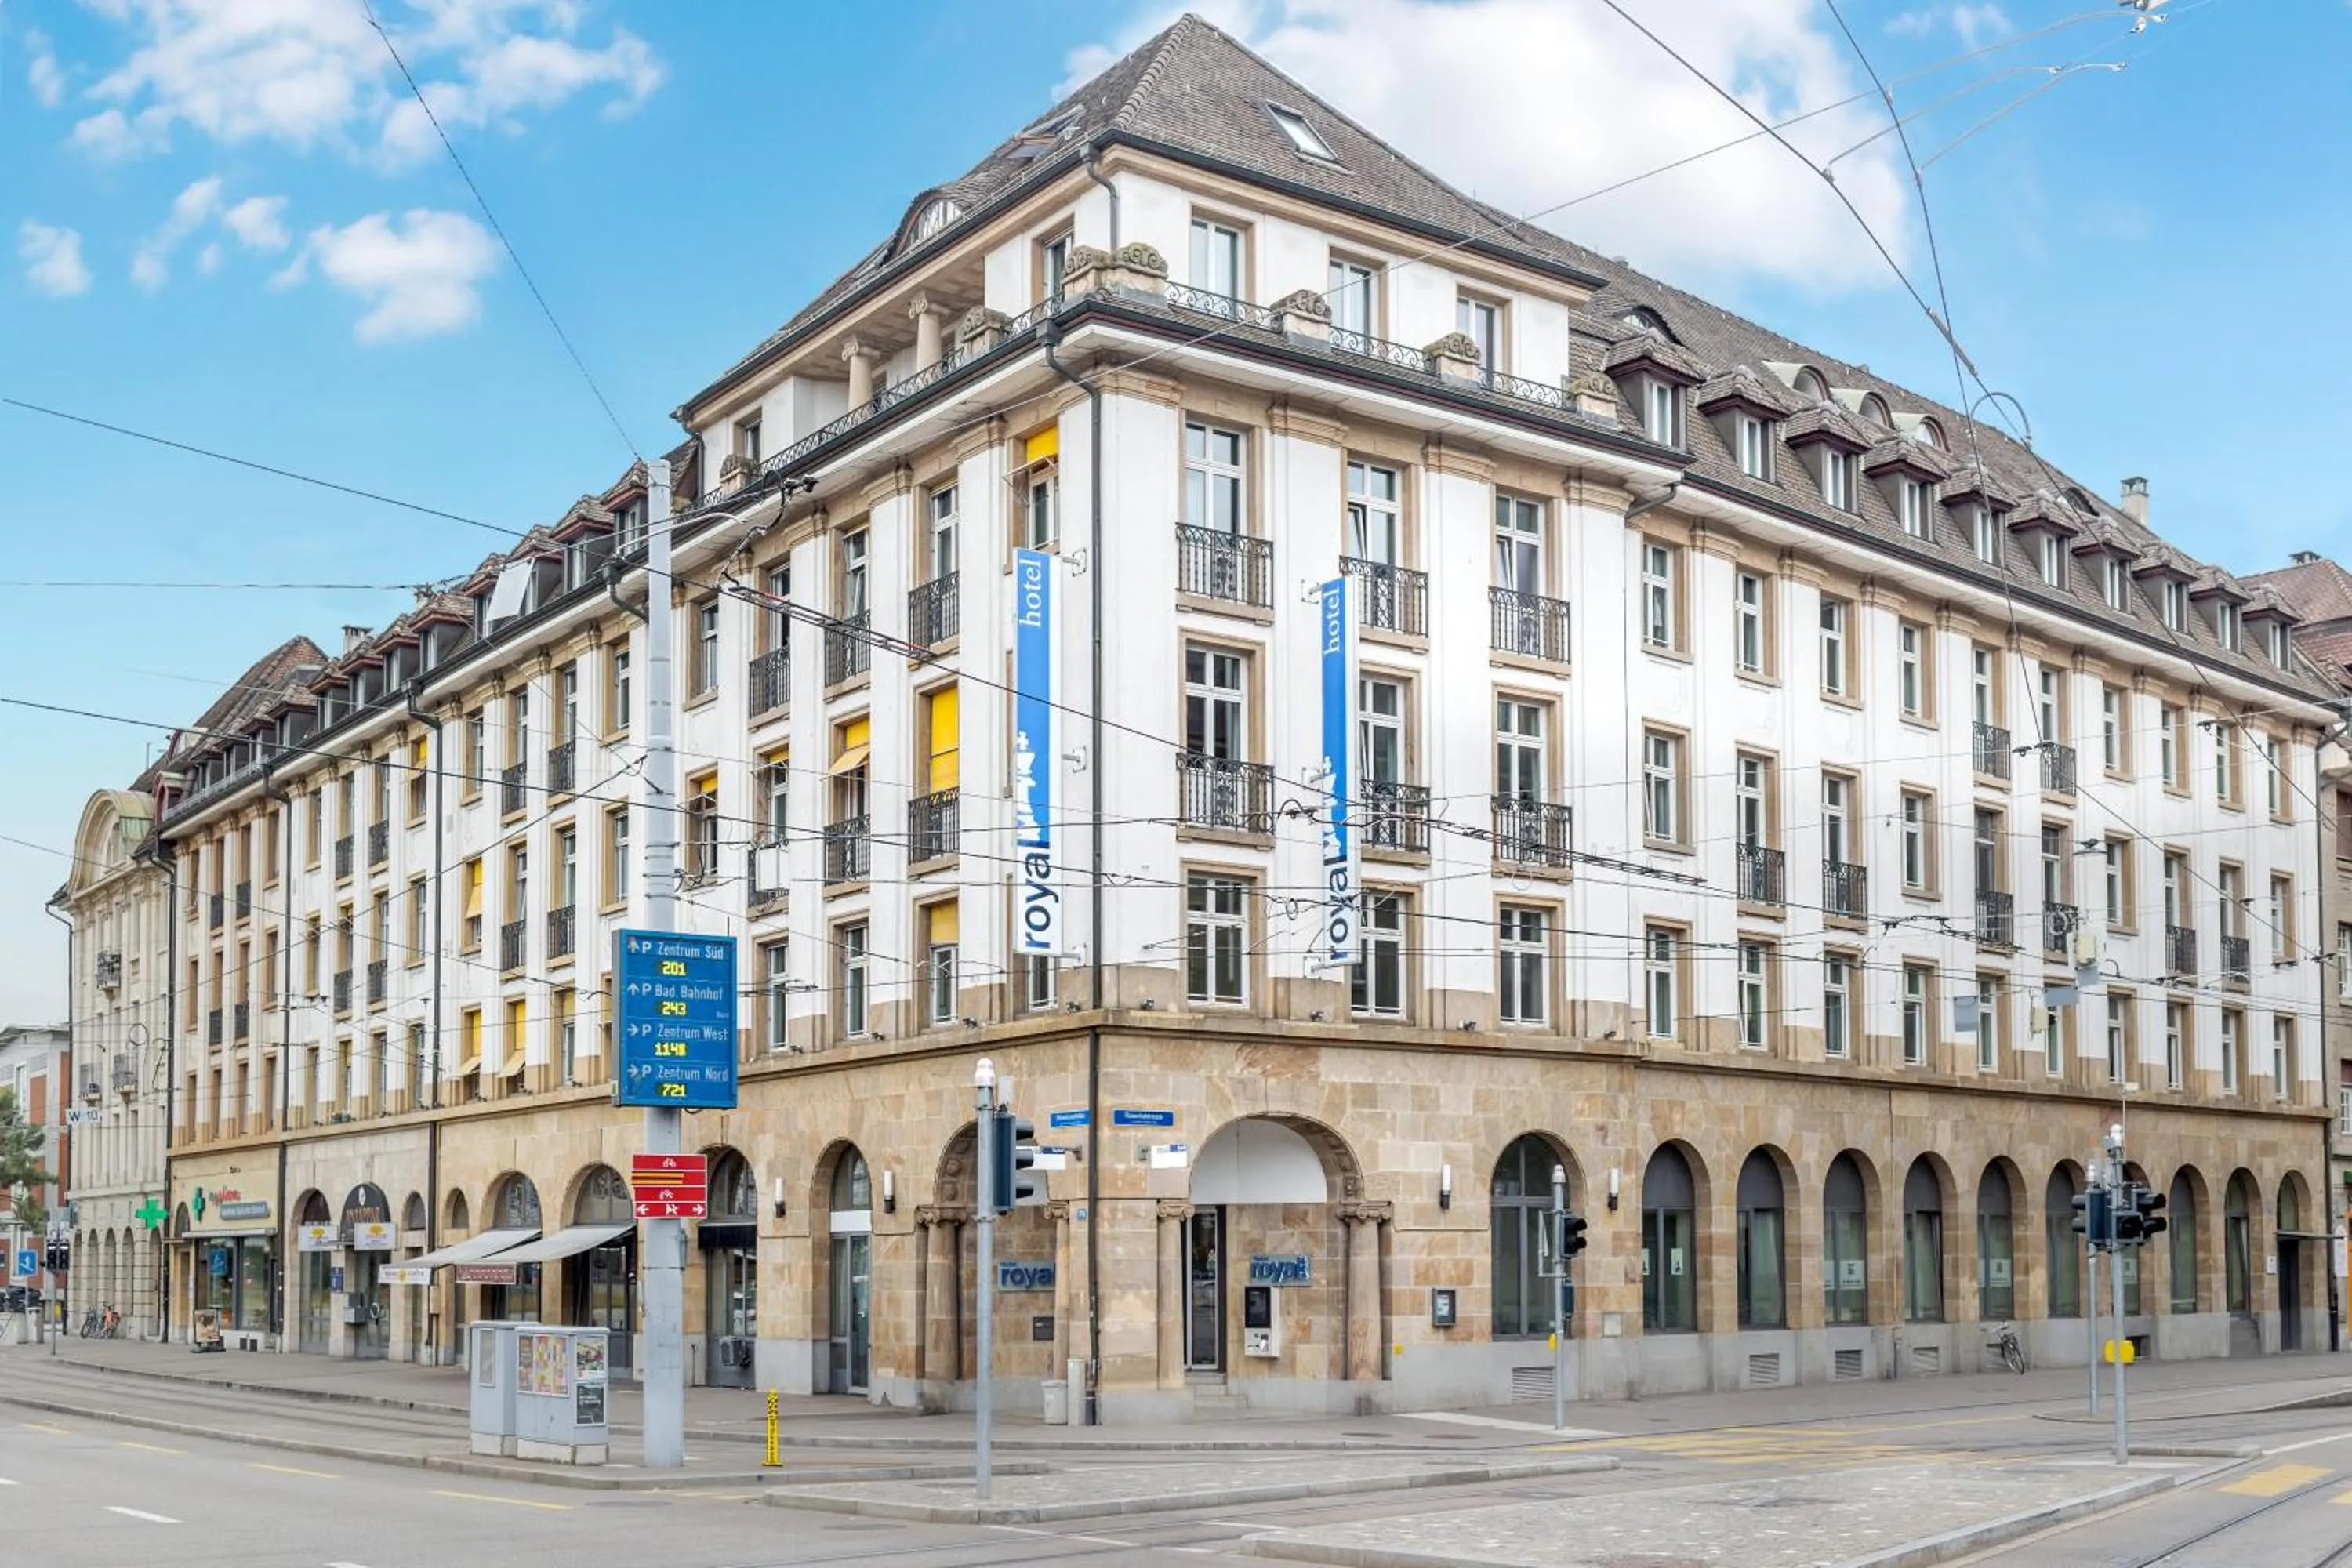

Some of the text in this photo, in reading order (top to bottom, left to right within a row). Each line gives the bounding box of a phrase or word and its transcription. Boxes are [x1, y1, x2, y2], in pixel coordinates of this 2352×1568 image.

[1019, 559, 1041, 626] hotel
[1323, 588, 1340, 654] hotel
[1017, 839, 1059, 949] royal
[1323, 855, 1354, 960] royal
[642, 942, 724, 960] P Zentrum Süd
[662, 961, 687, 976] 201
[642, 983, 652, 996] P
[681, 985, 723, 1000] Bahnhof
[662, 1001, 687, 1016] 243
[642, 1024, 728, 1040] P Zentrum West
[642, 1065, 728, 1082] P Zentrum Nord
[662, 1083, 687, 1098] 721
